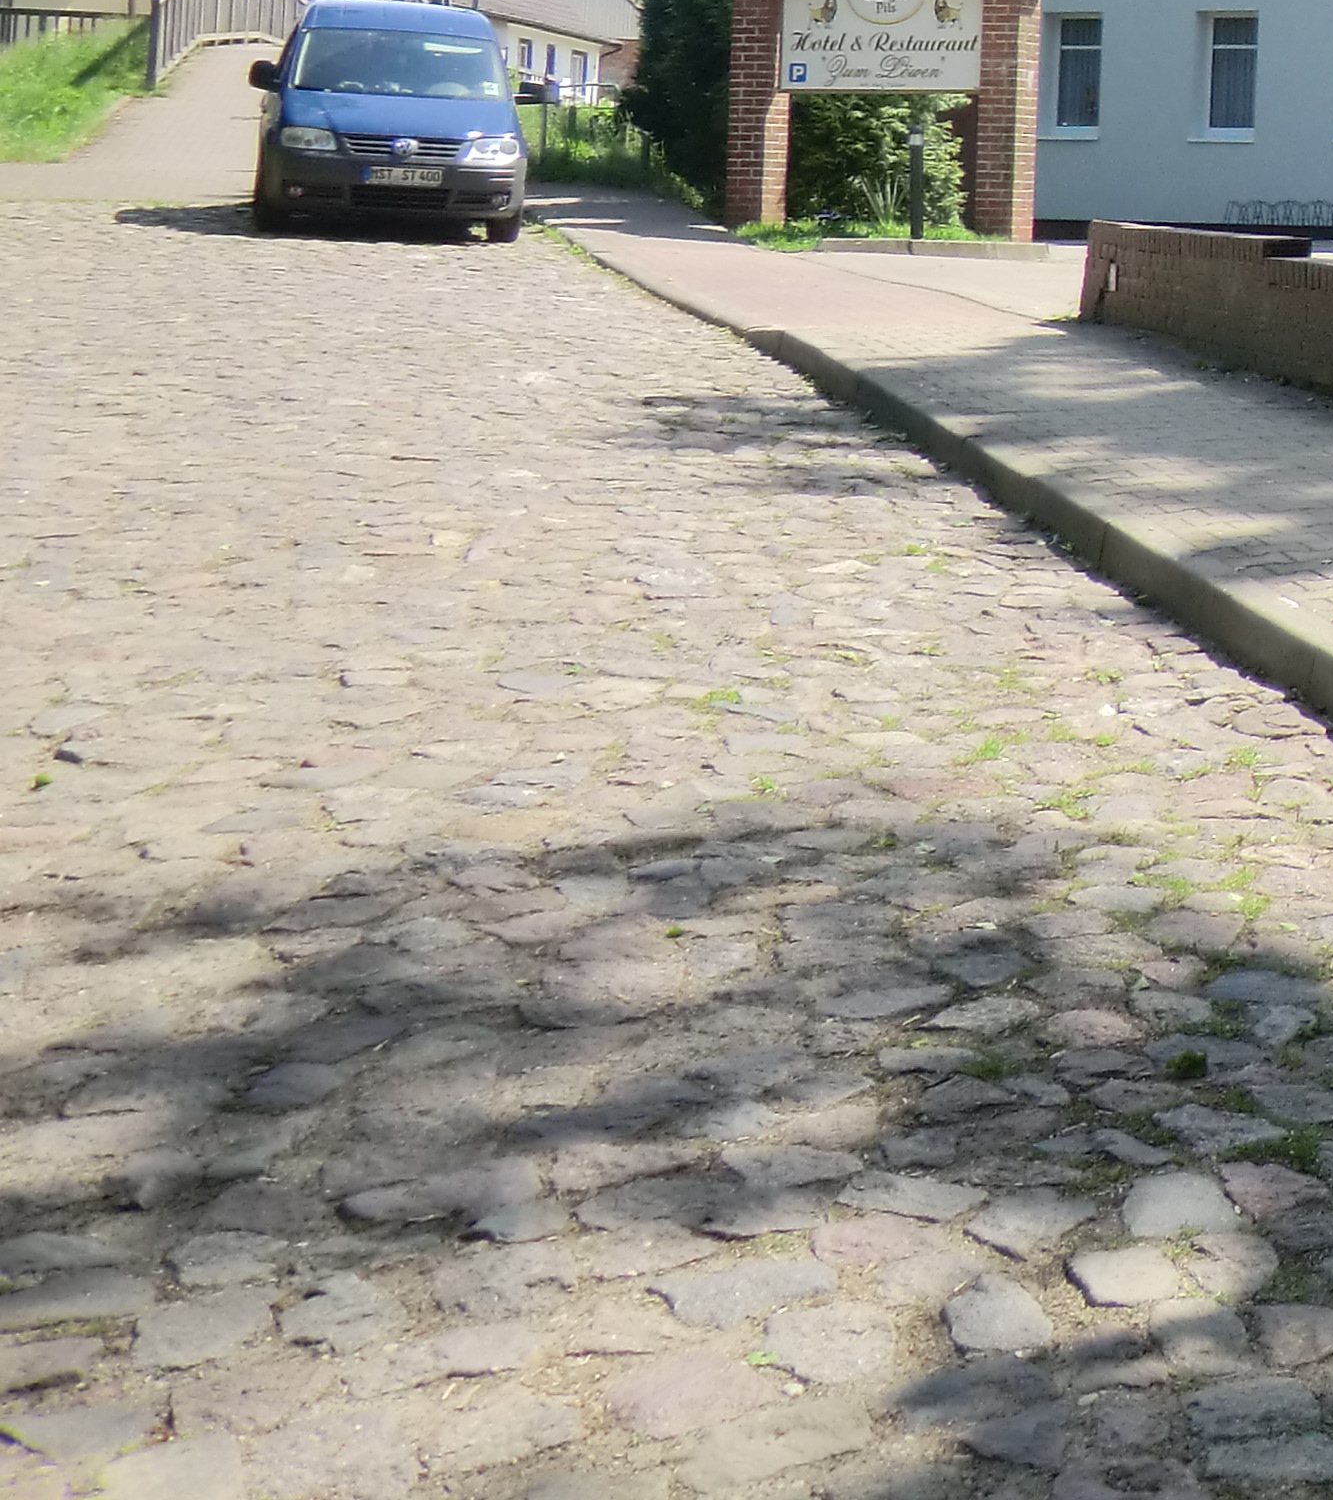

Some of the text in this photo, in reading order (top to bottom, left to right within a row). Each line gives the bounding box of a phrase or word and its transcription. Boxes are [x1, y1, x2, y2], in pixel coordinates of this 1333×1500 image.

[876, 2, 896, 14] Pils
[790, 32, 979, 51] Hotel & Restaurant
